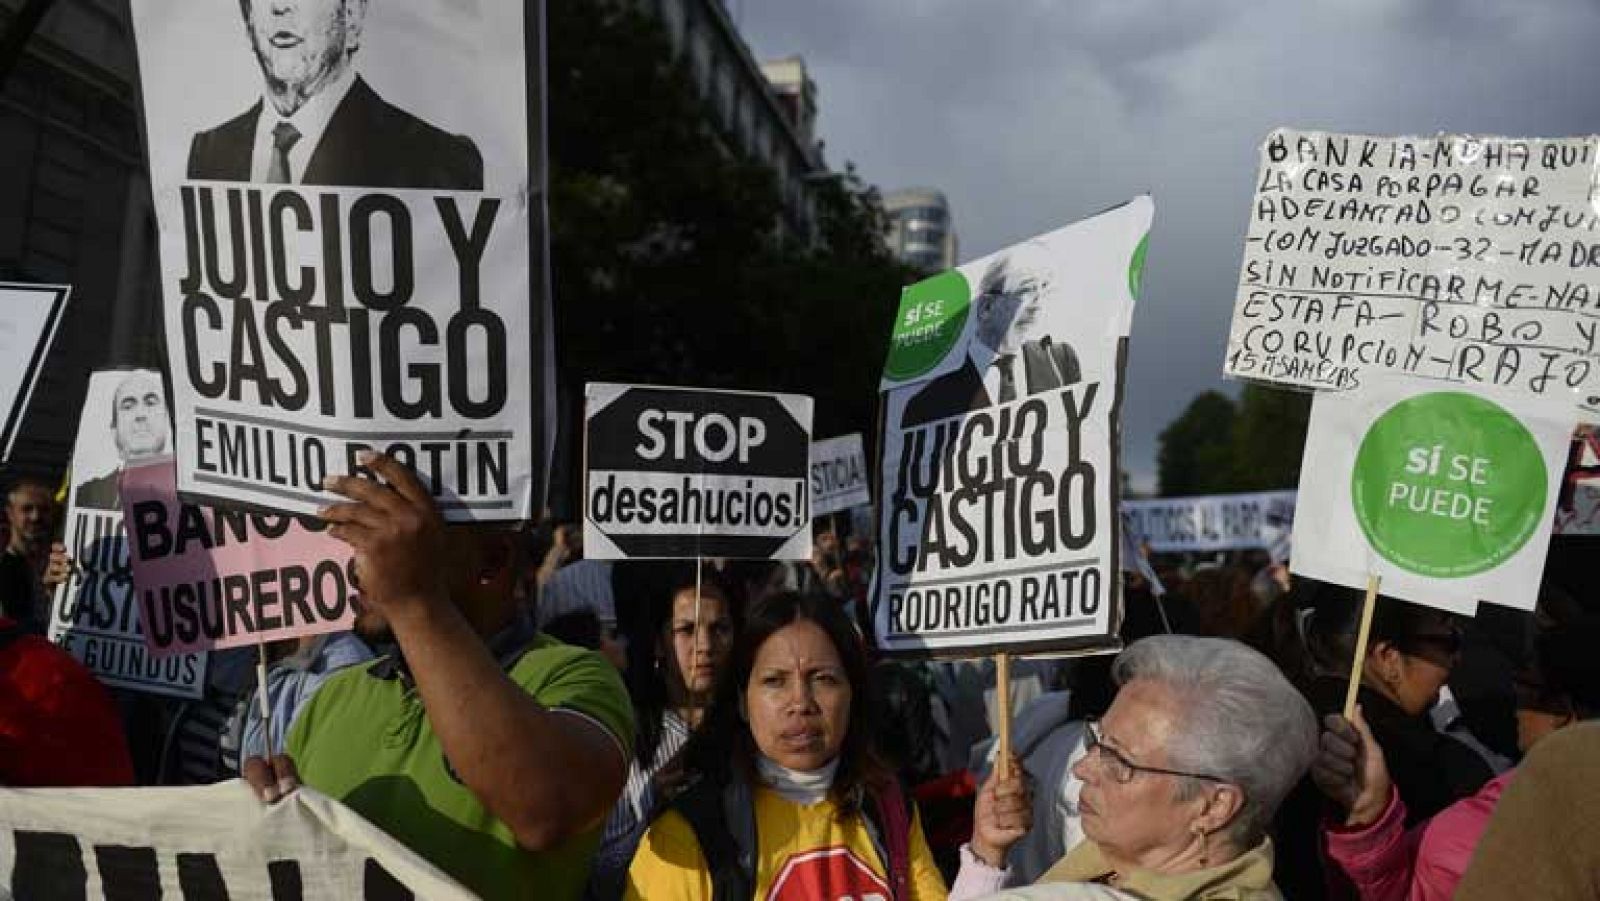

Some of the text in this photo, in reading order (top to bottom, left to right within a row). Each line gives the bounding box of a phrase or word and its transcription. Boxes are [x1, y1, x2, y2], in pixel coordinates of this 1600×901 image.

[1259, 168, 1292, 193] LA
[1303, 168, 1363, 193] CASA
[179, 185, 502, 314] JUICIO Y
[1247, 260, 1297, 287] SIN
[181, 293, 508, 421] CASTIGO
[195, 418, 327, 493] EMILIO
[634, 407, 768, 464] STOP
[895, 382, 1100, 501] JUICIO Y
[1448, 453, 1492, 486] SE
[590, 473, 803, 530] desahucios!
[888, 459, 1097, 576] CASTIGO
[1388, 481, 1493, 525] PUEDE
[56, 566, 135, 634] CAST
[888, 566, 1101, 634] RODRIGO RATO
